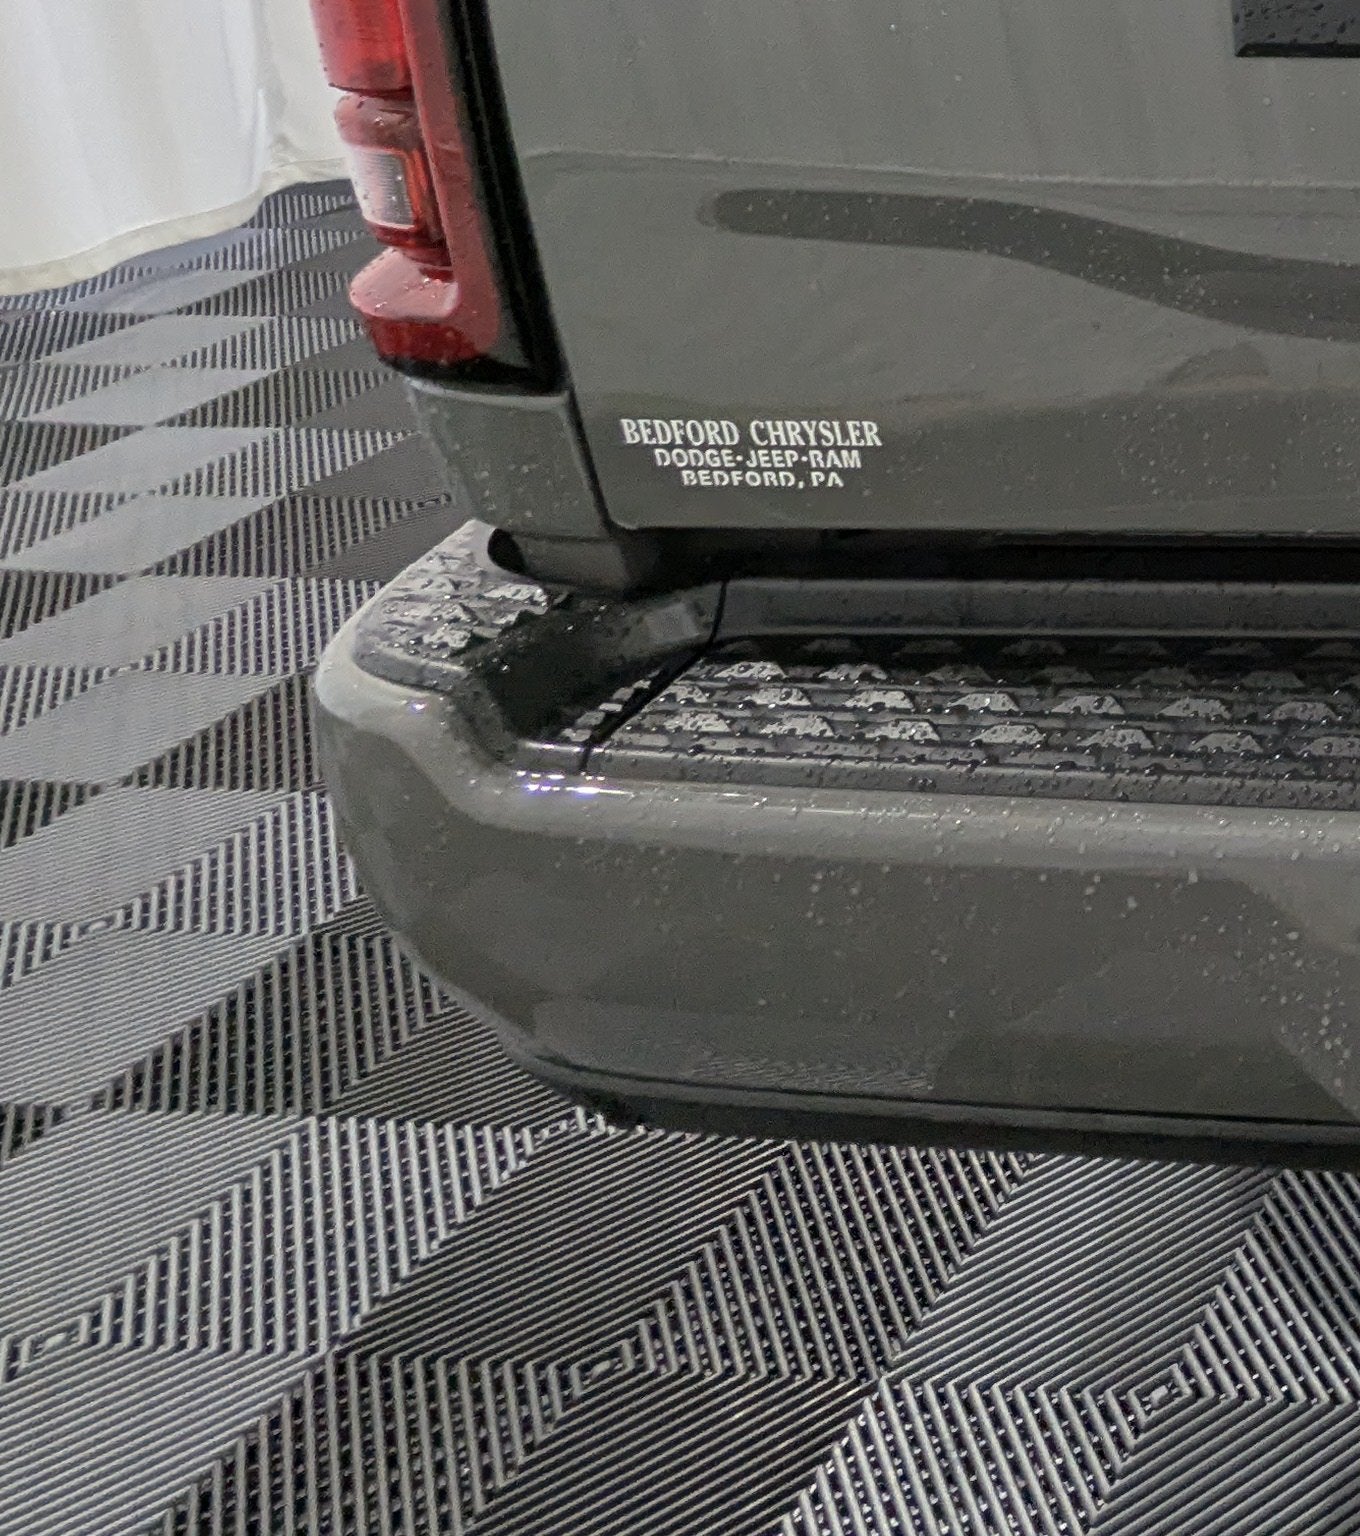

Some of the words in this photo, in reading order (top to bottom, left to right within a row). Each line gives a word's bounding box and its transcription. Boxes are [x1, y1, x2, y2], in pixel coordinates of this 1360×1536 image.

[619, 417, 741, 447] BEDFORD
[750, 419, 883, 449] CHRYSLER
[680, 469, 805, 490] BEDFORD,
[811, 470, 845, 488] PA
